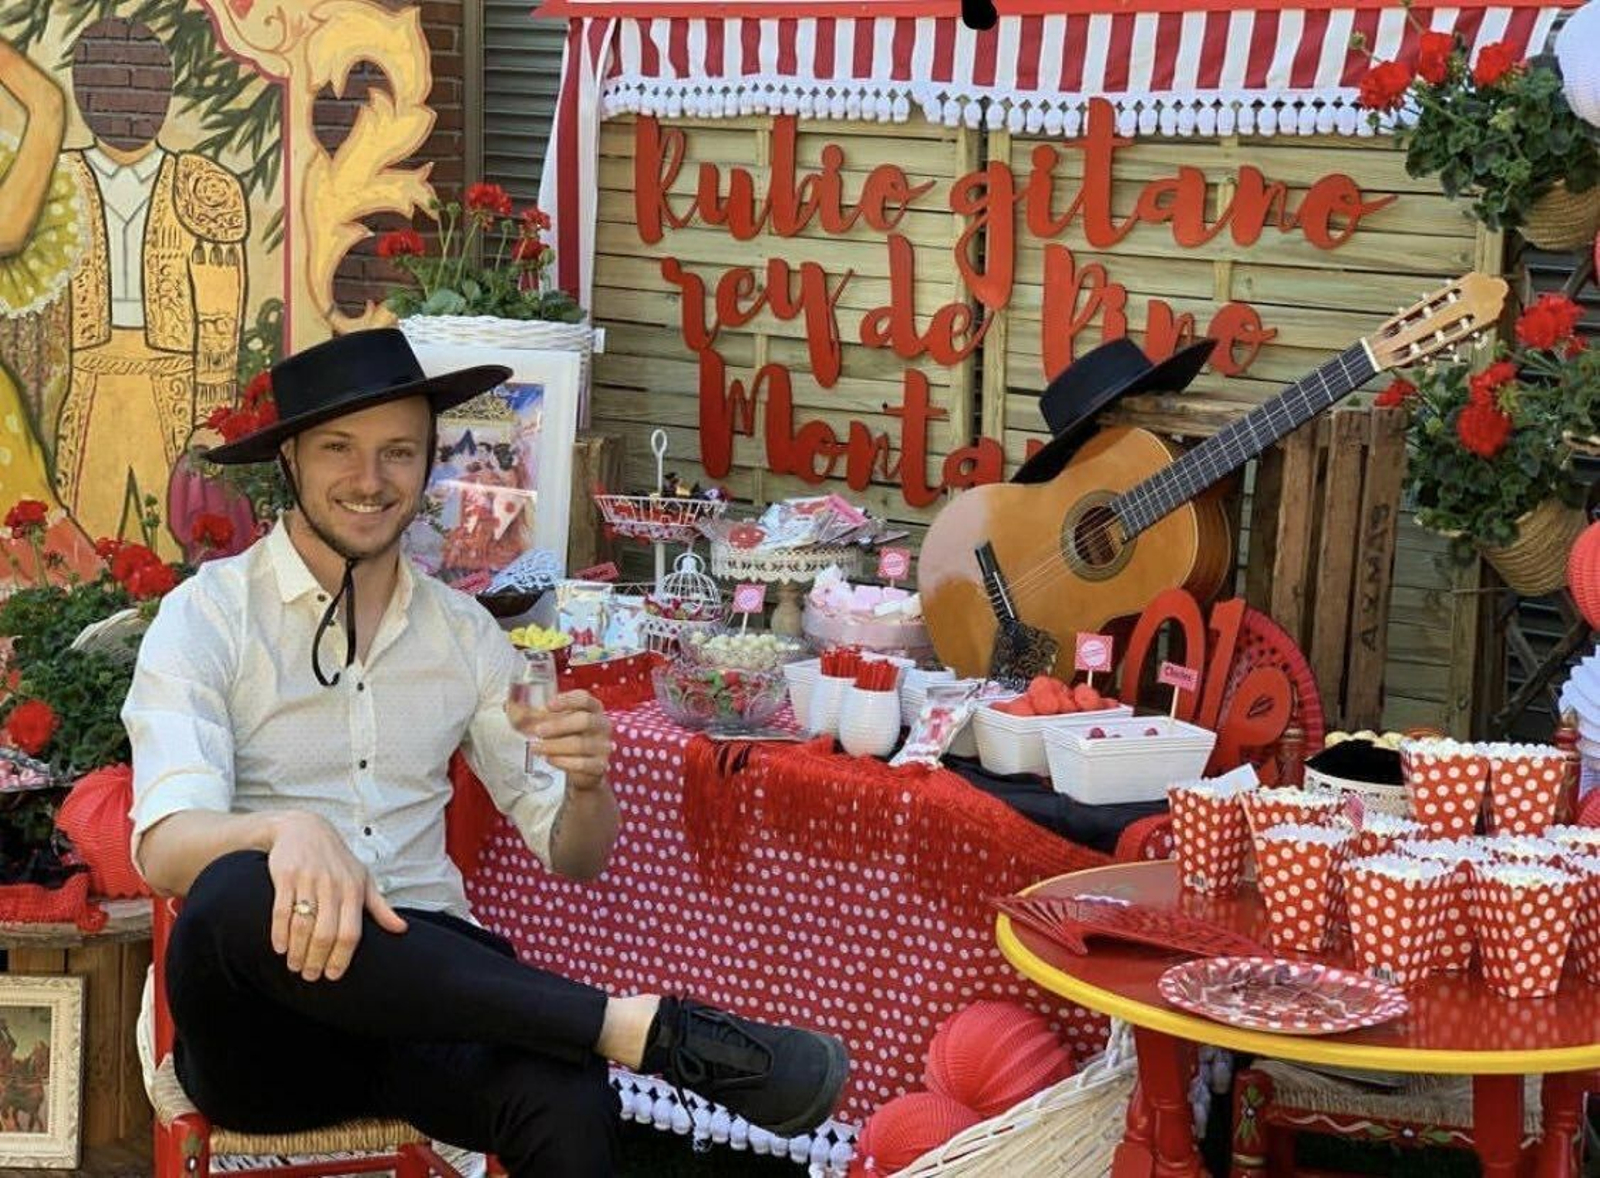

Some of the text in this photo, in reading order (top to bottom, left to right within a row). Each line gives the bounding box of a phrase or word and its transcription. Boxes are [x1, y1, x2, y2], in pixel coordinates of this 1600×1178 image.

[949, 97, 1397, 310] gitano
[660, 257, 853, 387] rey
[859, 234, 992, 366] de
